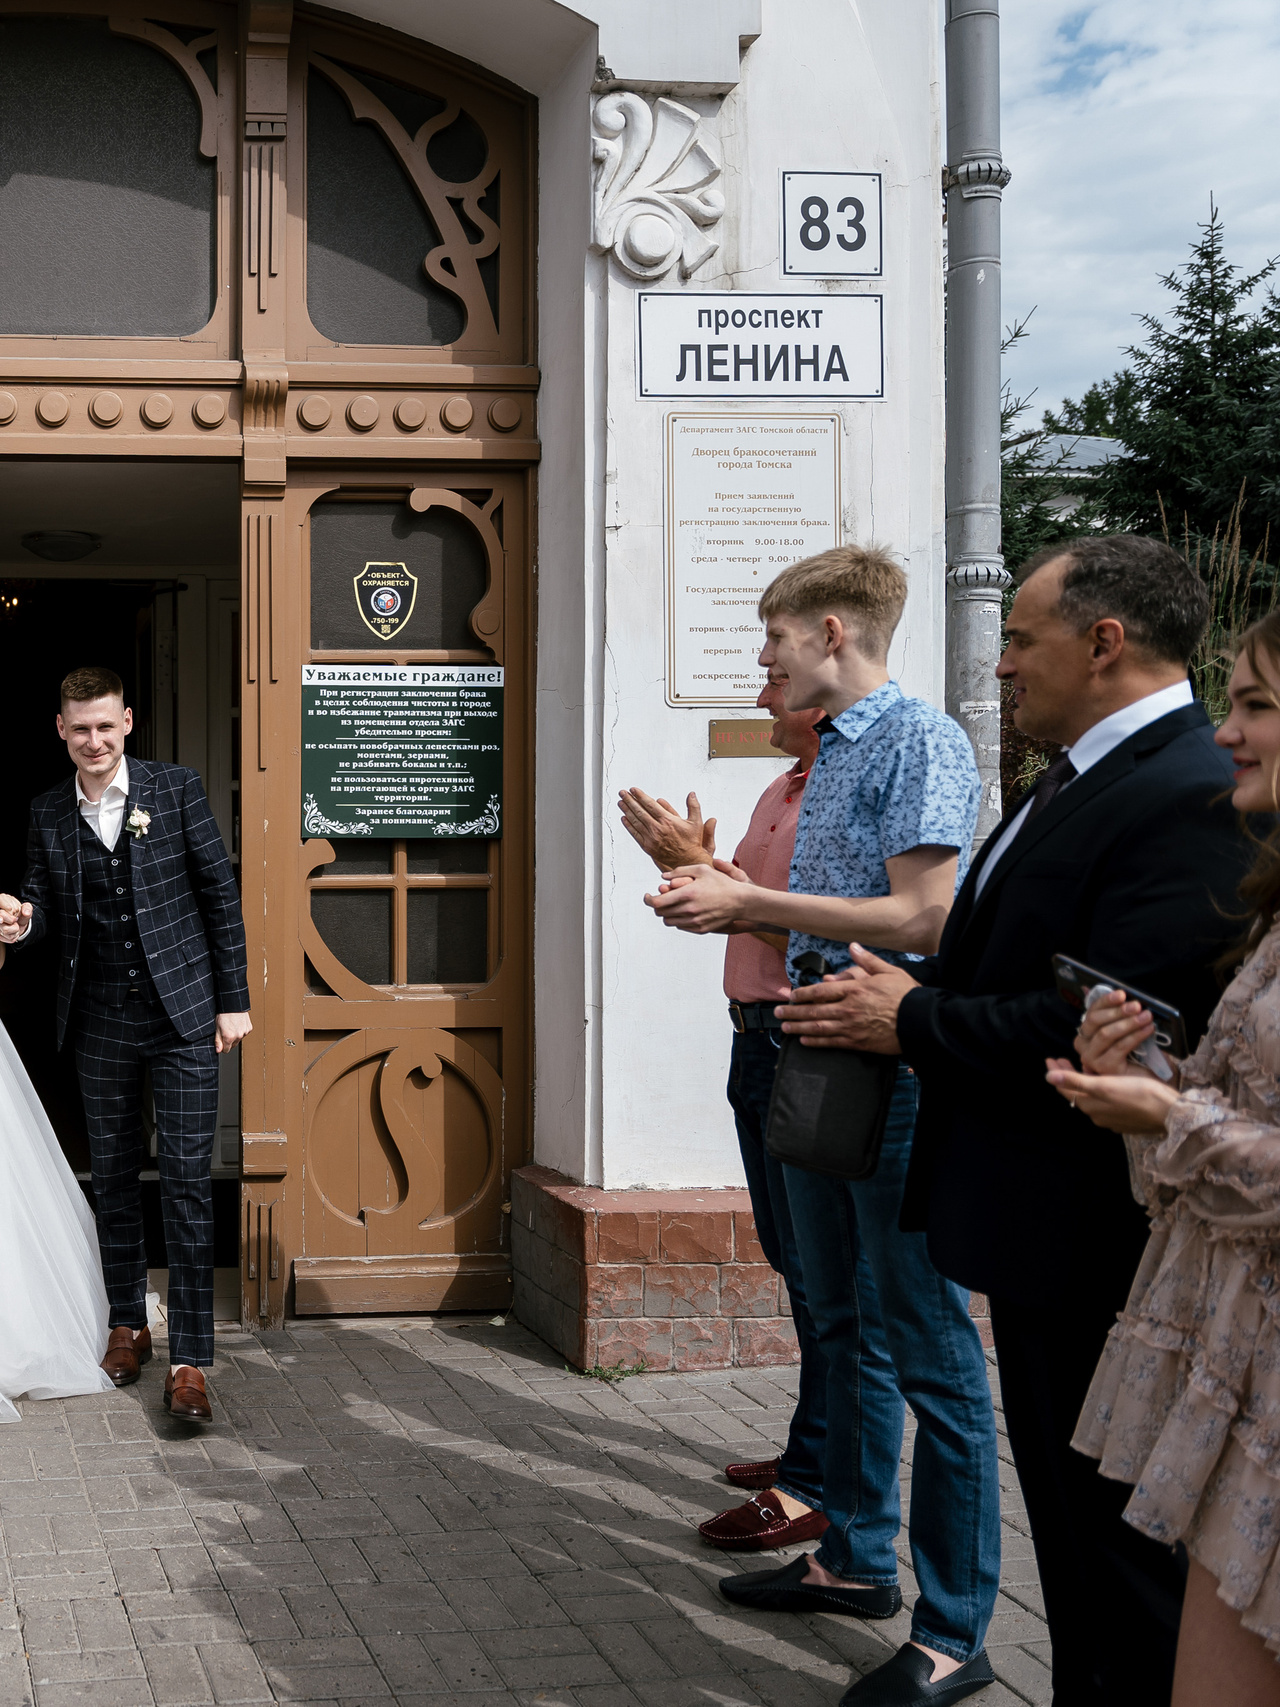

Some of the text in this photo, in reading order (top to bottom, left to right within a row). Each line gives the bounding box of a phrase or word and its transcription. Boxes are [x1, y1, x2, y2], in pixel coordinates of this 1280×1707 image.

[799, 195, 867, 252] 83
[697, 308, 823, 336] проспект
[675, 343, 850, 383] ЛЕНИНА
[679, 425, 829, 435] Департамент ЗАГС Томской области
[691, 446, 817, 458] Дворец бракосочетаний
[717, 460, 793, 470] города Томска
[714, 491, 795, 501] Прием заявлений
[721, 506, 802, 514] государственную
[679, 517, 831, 528] регистрацию заключения брака.
[754, 538, 805, 546] 9.00-18.00
[690, 556, 718, 564] среда
[726, 556, 762, 564] четверг
[685, 585, 764, 595] Государственная
[703, 647, 743, 656] перерыв
[304, 668, 502, 685] Уважаемые граждане!
[692, 673, 751, 681] воскресенье
[320, 689, 338, 698] При
[340, 689, 399, 699] регистрации
[459, 689, 487, 699] брака
[352, 698, 409, 708] соблюдения
[329, 707, 381, 716] избежание
[383, 709, 442, 718] травматизма
[444, 710, 461, 718] при
[353, 719, 407, 727] помещения
[408, 719, 440, 727] отдела
[441, 718, 466, 727] ЗАГС
[354, 727, 452, 737] убедительно просим:
[715, 732, 735, 743] НЕ
[360, 742, 424, 751] новобрачных
[481, 744, 500, 752] роз,
[352, 759, 400, 769] разбивать
[402, 760, 437, 768] бокалы
[409, 776, 475, 785] пиротехникой
[343, 785, 408, 793] прилегающей
[355, 807, 451, 816] Заранее благодарим
